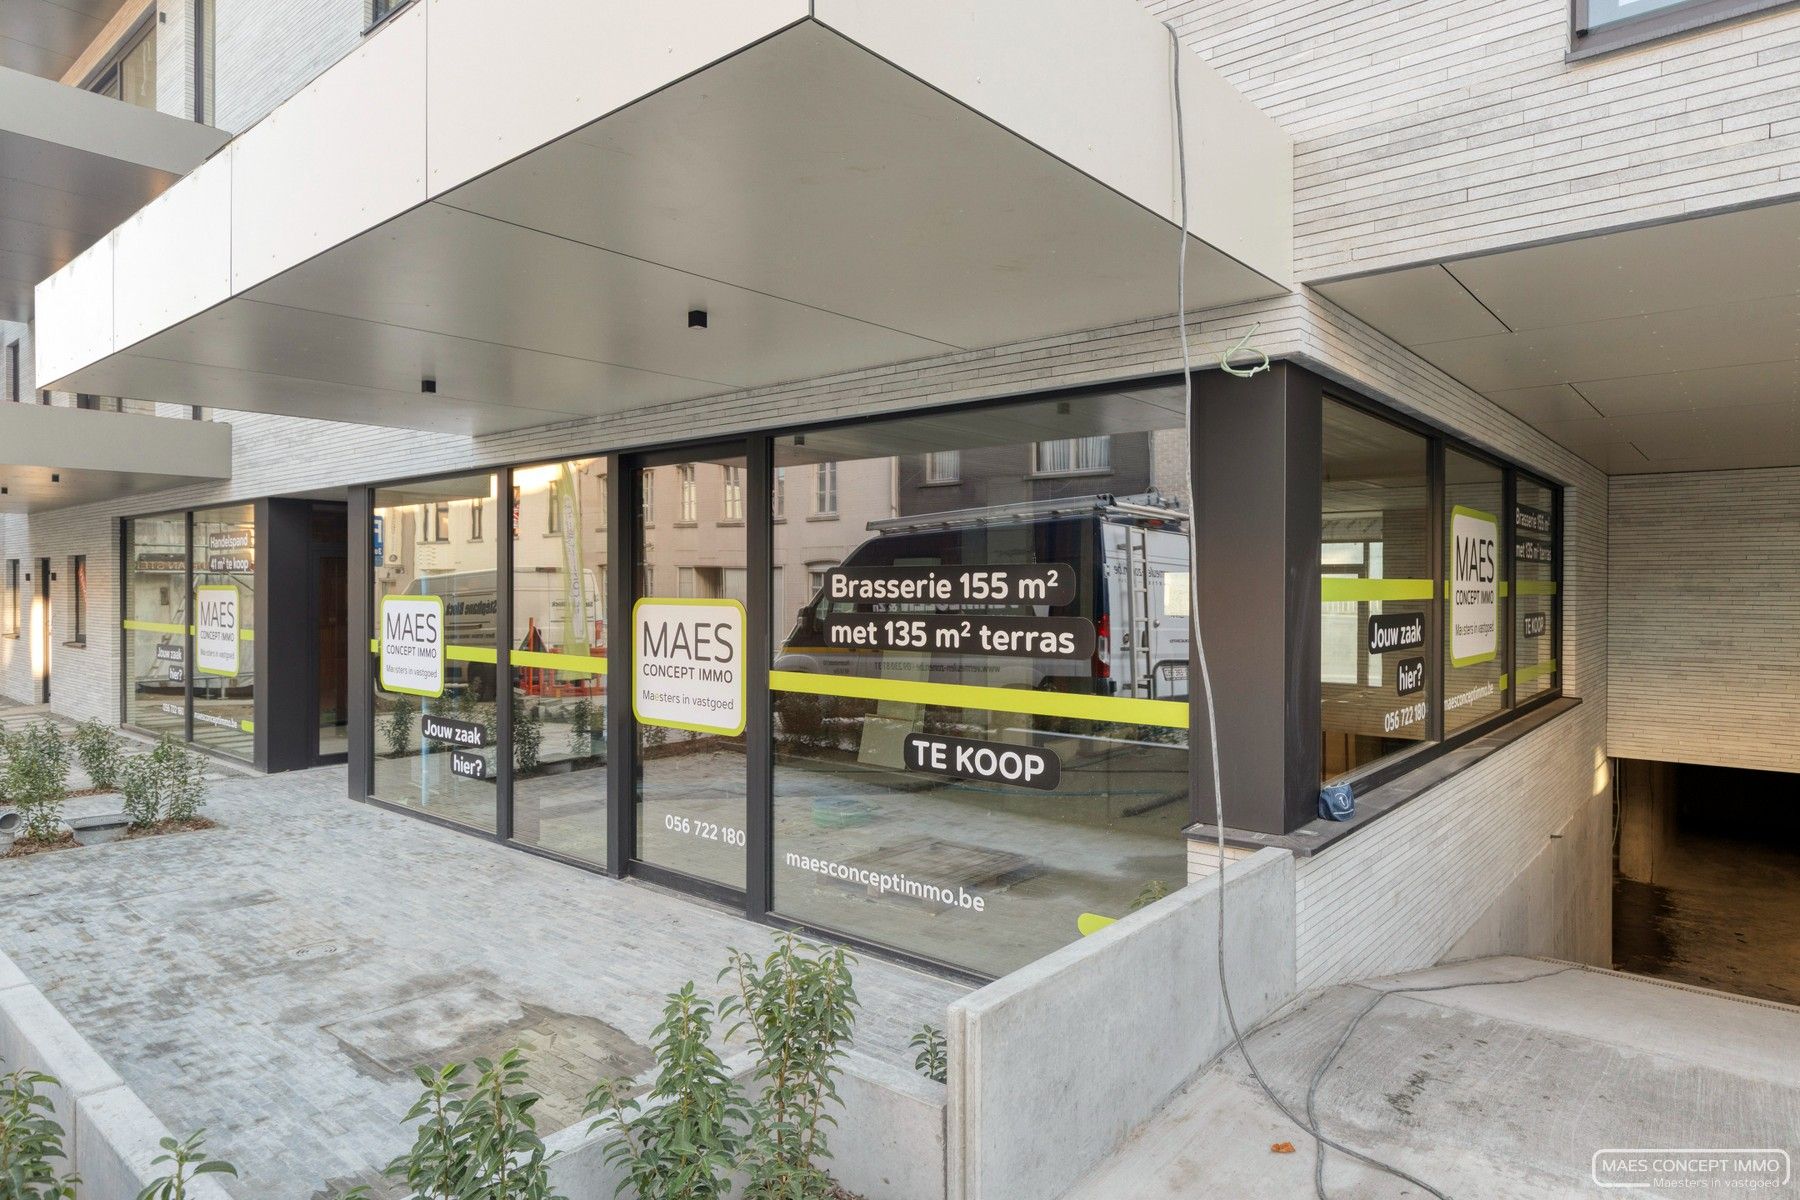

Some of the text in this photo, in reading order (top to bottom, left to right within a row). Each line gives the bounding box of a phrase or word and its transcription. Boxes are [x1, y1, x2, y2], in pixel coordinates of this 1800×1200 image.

[210, 533, 248, 549] Handelspand
[226, 560, 232, 569] te
[233, 557, 248, 571] koop
[1456, 535, 1494, 583] MAES
[831, 570, 1059, 600] Brasserie 155 m²
[1456, 589, 1494, 606] CONCEPT IMMO
[200, 601, 235, 629] MAES
[386, 612, 437, 644] MAES
[200, 630, 220, 640] CONCEPT
[642, 621, 734, 664] MAES
[831, 621, 1075, 655] met 135 m² terras
[1371, 618, 1422, 649] Jouw zaak
[158, 646, 182, 660] Jouw zaak
[386, 644, 437, 659] CONCEPT IMMO
[170, 666, 183, 680] hier?
[386, 664, 407, 675] Masters
[642, 663, 734, 684] CONCEPT IMMO
[1400, 663, 1422, 691] hier?
[682, 694, 690, 705] in
[692, 697, 734, 712] vastgoed
[1384, 701, 1426, 733] 056 722 180
[424, 719, 482, 745] Jouw zaak
[453, 755, 483, 776] hier?
[912, 740, 1044, 782] TE KOOP
[665, 814, 746, 847] 056 722 180
[786, 850, 985, 913] maesconceptimmo.be
